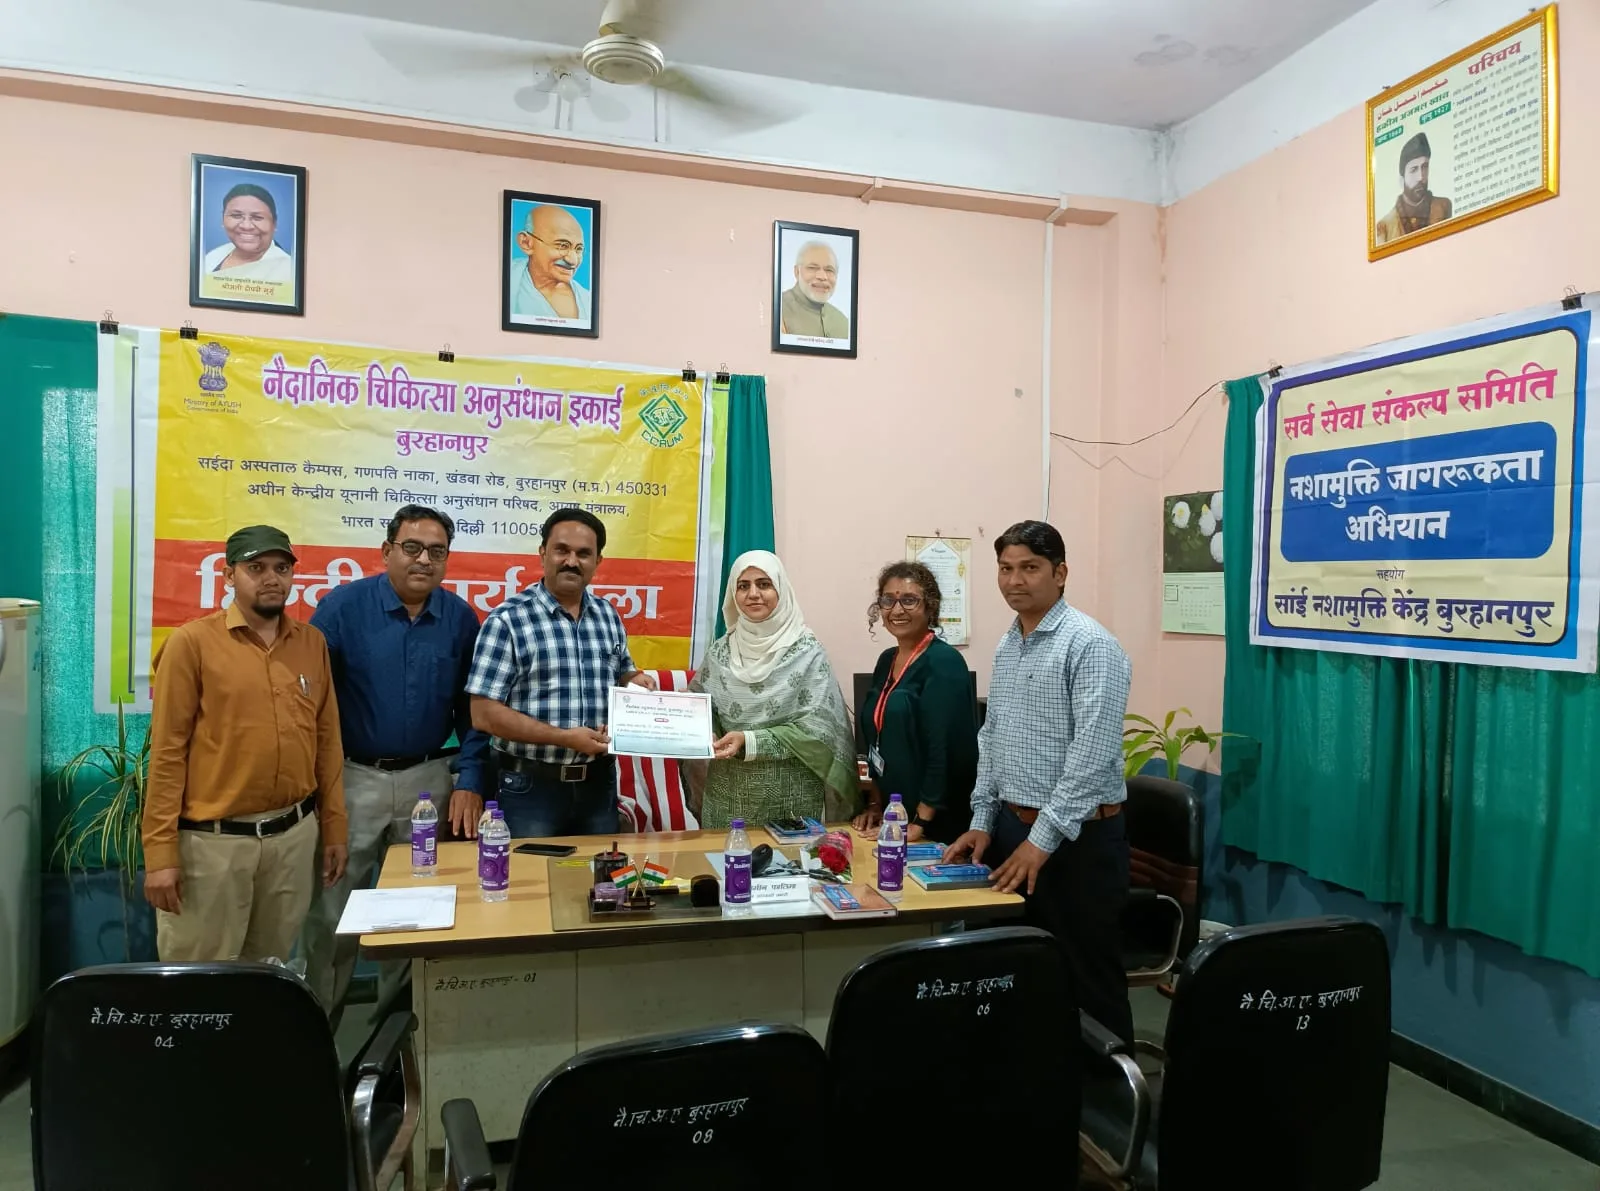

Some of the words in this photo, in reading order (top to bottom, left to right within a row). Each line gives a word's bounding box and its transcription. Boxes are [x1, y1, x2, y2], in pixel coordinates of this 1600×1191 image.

[1468, 41, 1522, 75] परिचय
[264, 356, 360, 404] नैदानिक
[367, 363, 457, 412] चिकित्सा
[464, 378, 563, 429] अनुसंधान
[569, 387, 624, 431] इकाई
[1284, 402, 1316, 440] सर्व
[1321, 400, 1366, 434] सेवा
[1372, 388, 1450, 426] संकल्प
[1457, 362, 1558, 413] समिति
[397, 430, 488, 460] बुरहानपुर
[198, 455, 234, 471] सईदा
[240, 459, 297, 473] अस्पताल
[303, 459, 348, 479] कैम्पस,
[354, 465, 398, 480] गणपति
[404, 469, 439, 485] नाका,
[446, 469, 480, 485] खंडवा
[485, 471, 509, 489] रोड,
[515, 476, 567, 494] बुरहानपुर
[572, 479, 610, 495] (म.प्र.)
[616, 481, 667, 497] 450331
[1290, 459, 1381, 509] नशामुक्ति
[1386, 449, 1544, 491] जागरूकता
[248, 480, 286, 496] अधीन
[292, 482, 335, 499] केन्द्रीय
[340, 486, 379, 504] यूनानी
[384, 488, 438, 505] चिकित्सा
[443, 493, 499, 510] अनुसंधान
[503, 495, 543, 512] परिषद,
[341, 515, 374, 528] भारत
[456, 519, 485, 536] दिल्ली
[1345, 505, 1451, 541] अभियान
[1376, 567, 1406, 581] सहयोग
[1312, 587, 1387, 628] नशामुक्ति
[1392, 588, 1430, 627] केंद्र
[1436, 598, 1555, 638] बुरहानपुर
[977, 1002, 991, 1016] 06
[1296, 1014, 1311, 1031] 13
[154, 1035, 175, 1048] 04
[692, 1128, 714, 1144] 08
